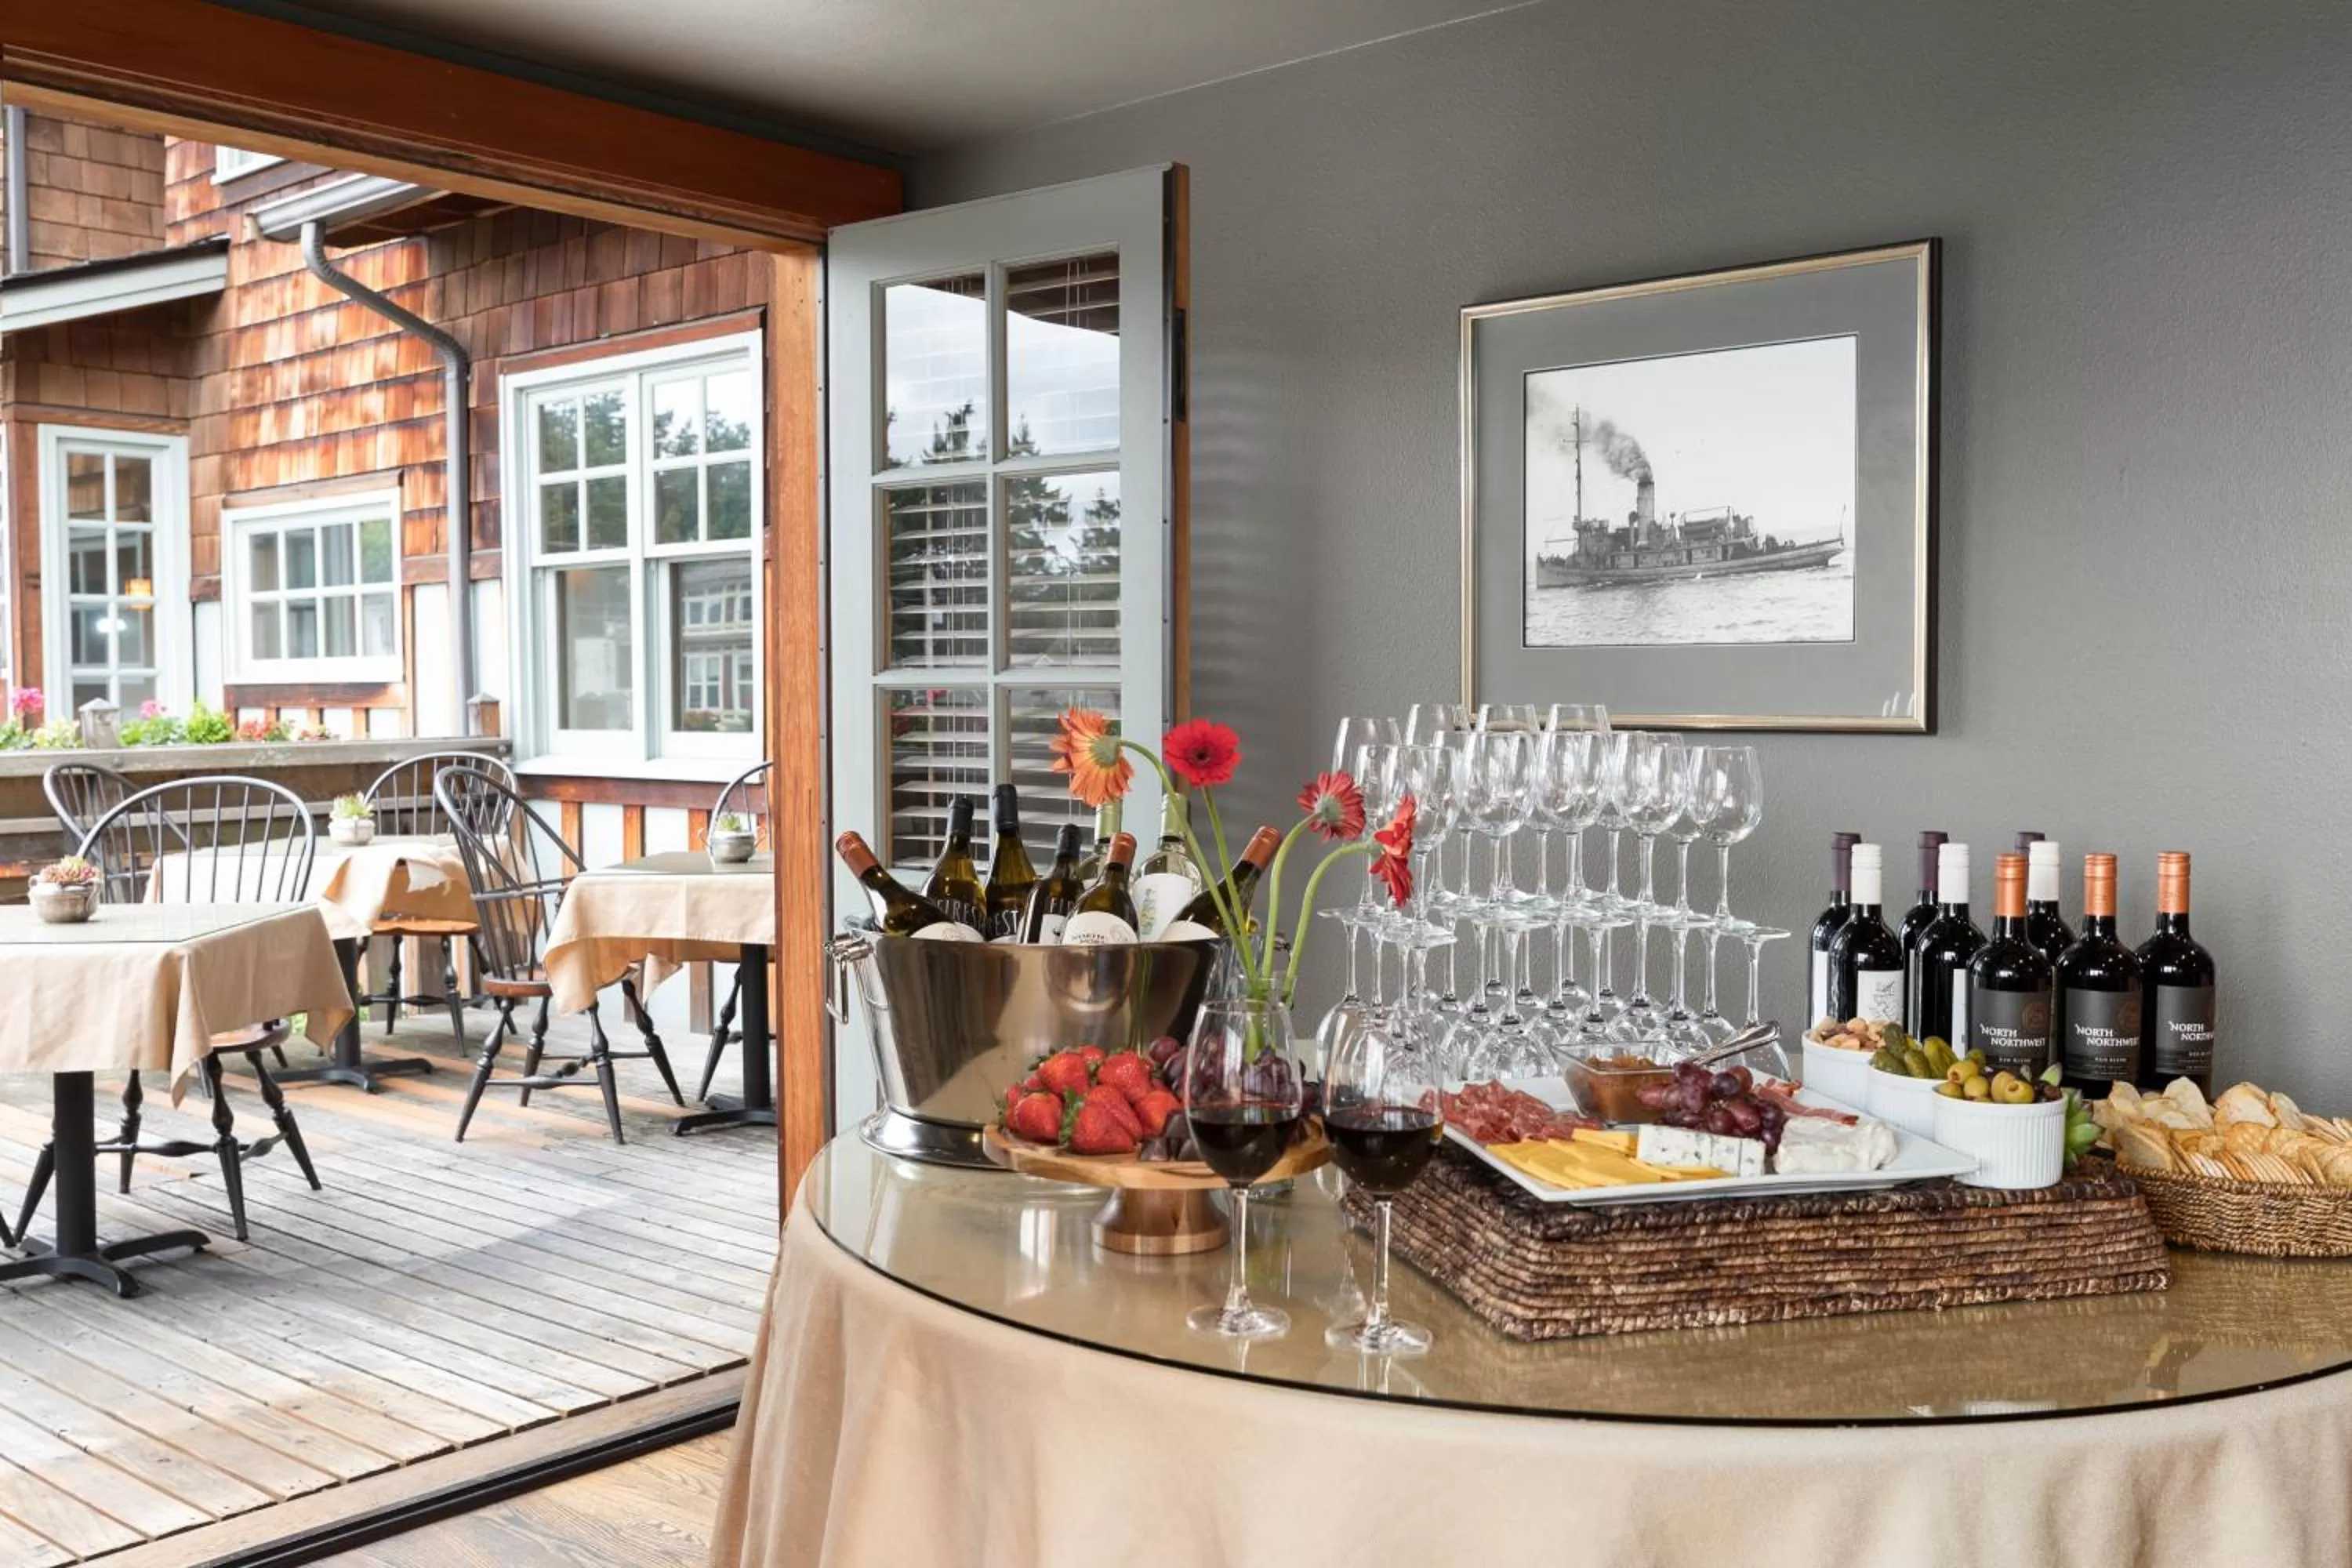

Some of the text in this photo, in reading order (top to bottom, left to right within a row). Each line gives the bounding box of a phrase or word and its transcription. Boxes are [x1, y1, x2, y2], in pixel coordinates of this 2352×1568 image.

[1980, 1023, 2017, 1038] NORTH
[2074, 1023, 2113, 1037] NORTH
[2168, 1020, 2205, 1033] NORTH
[2086, 1036, 2140, 1047] NORTHWES
